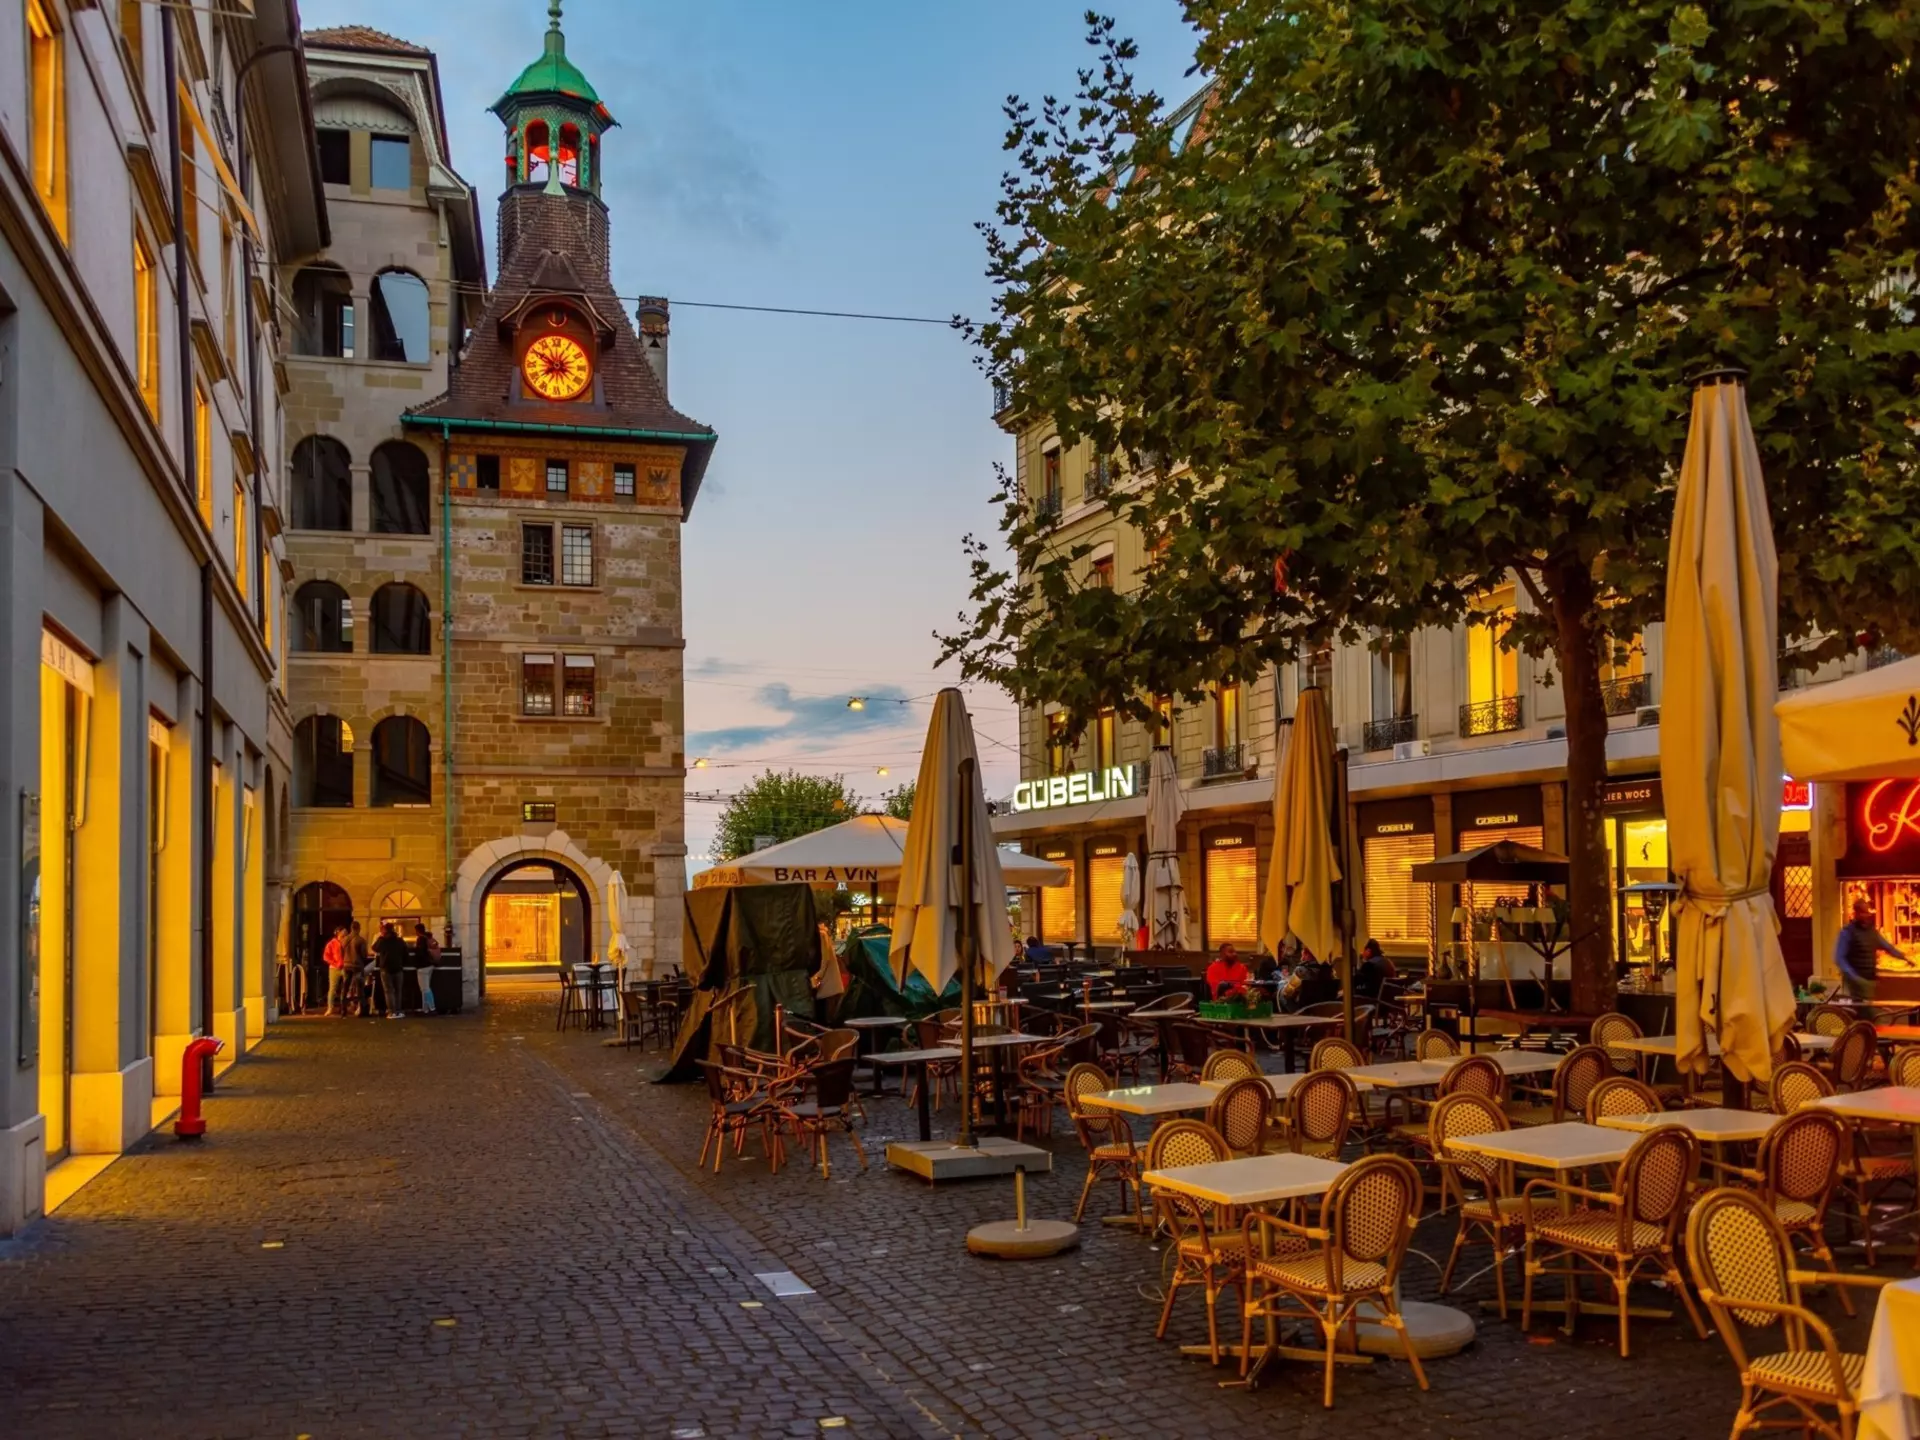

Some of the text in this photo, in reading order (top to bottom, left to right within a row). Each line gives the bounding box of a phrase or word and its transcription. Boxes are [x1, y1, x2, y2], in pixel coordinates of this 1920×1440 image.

[1013, 765, 1134, 811] GÜBELIN
[1624, 789, 1651, 799] WOCS
[774, 866, 878, 881] BAR À VIN
